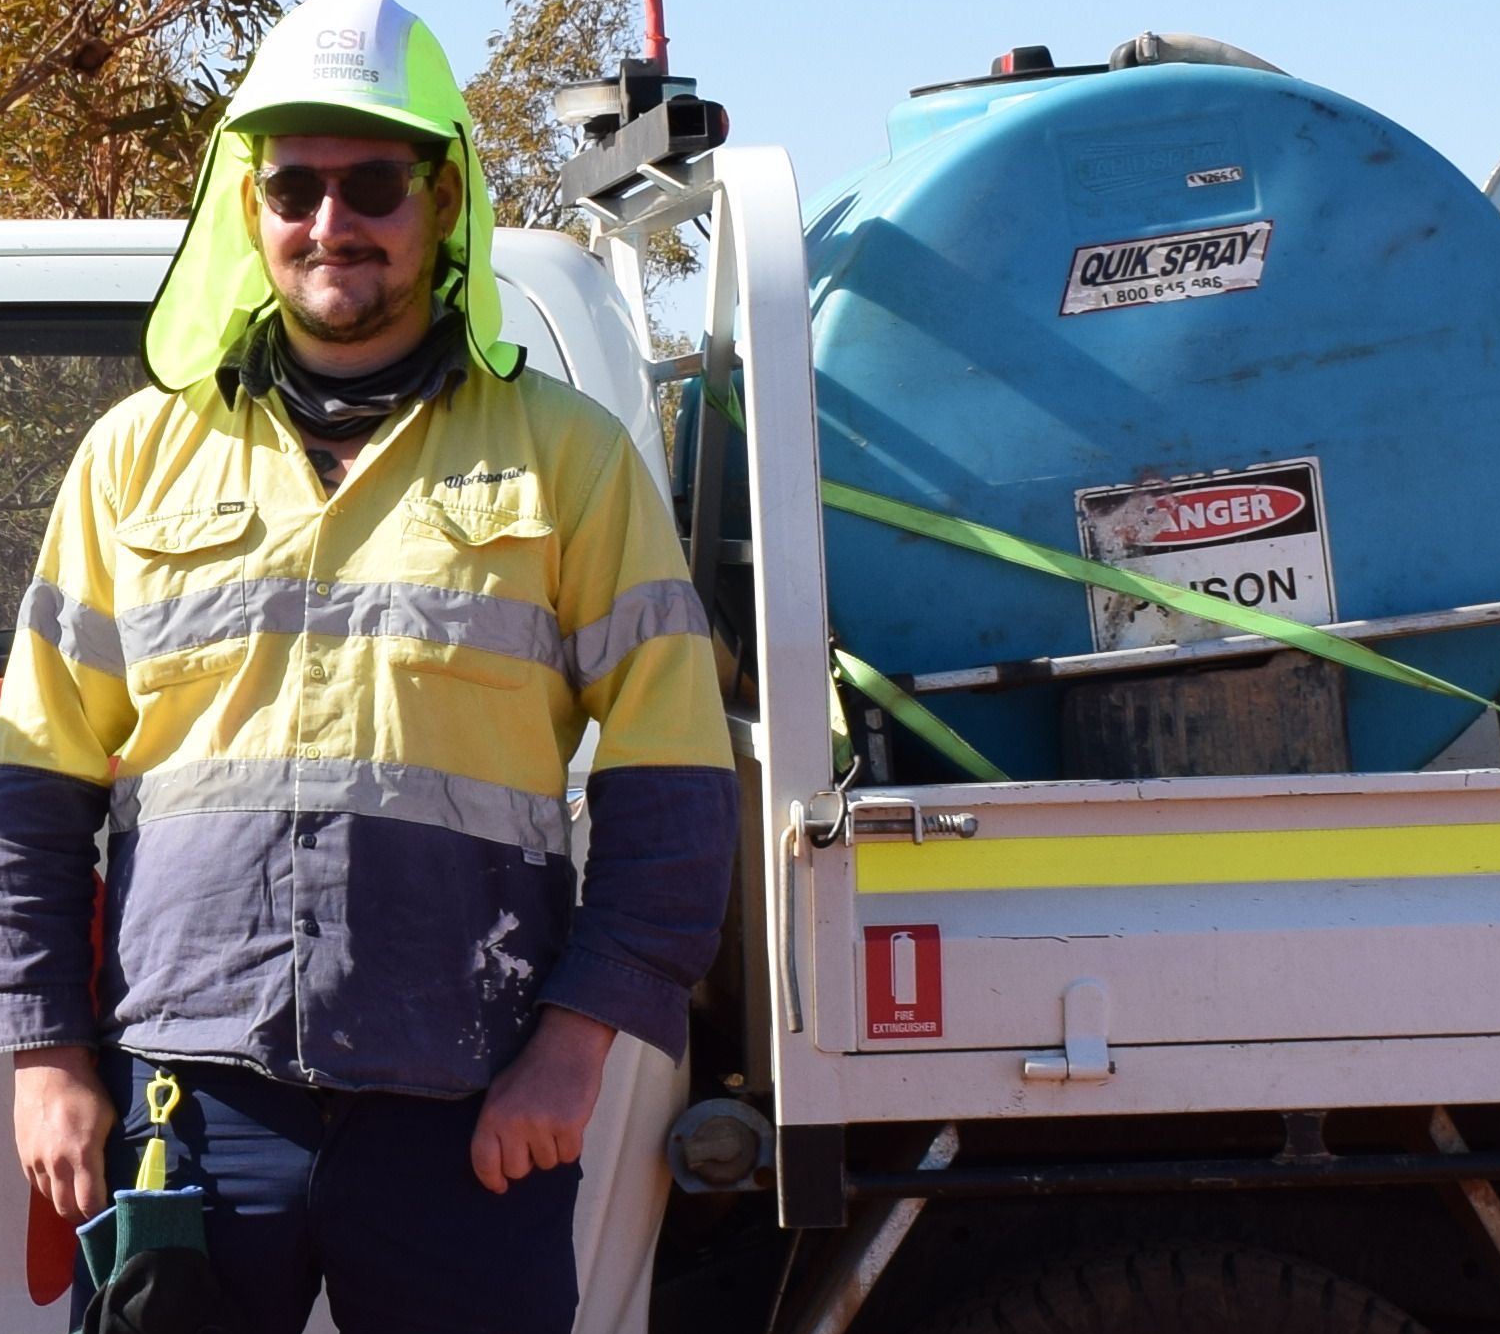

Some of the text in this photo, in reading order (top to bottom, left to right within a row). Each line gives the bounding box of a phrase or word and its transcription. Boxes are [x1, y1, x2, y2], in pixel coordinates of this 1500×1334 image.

[316, 29, 365, 51] CSI
[313, 52, 365, 66] MINING
[312, 66, 379, 83] SERVICES
[1080, 229, 1260, 287] QUIK SPRAY
[1102, 291, 1109, 306] 1
[1116, 286, 1148, 303] 800
[1155, 493, 1276, 534] ANGER
[894, 1010, 915, 1021] FIRE
[872, 1022, 937, 1034] EXTINGUISHER
